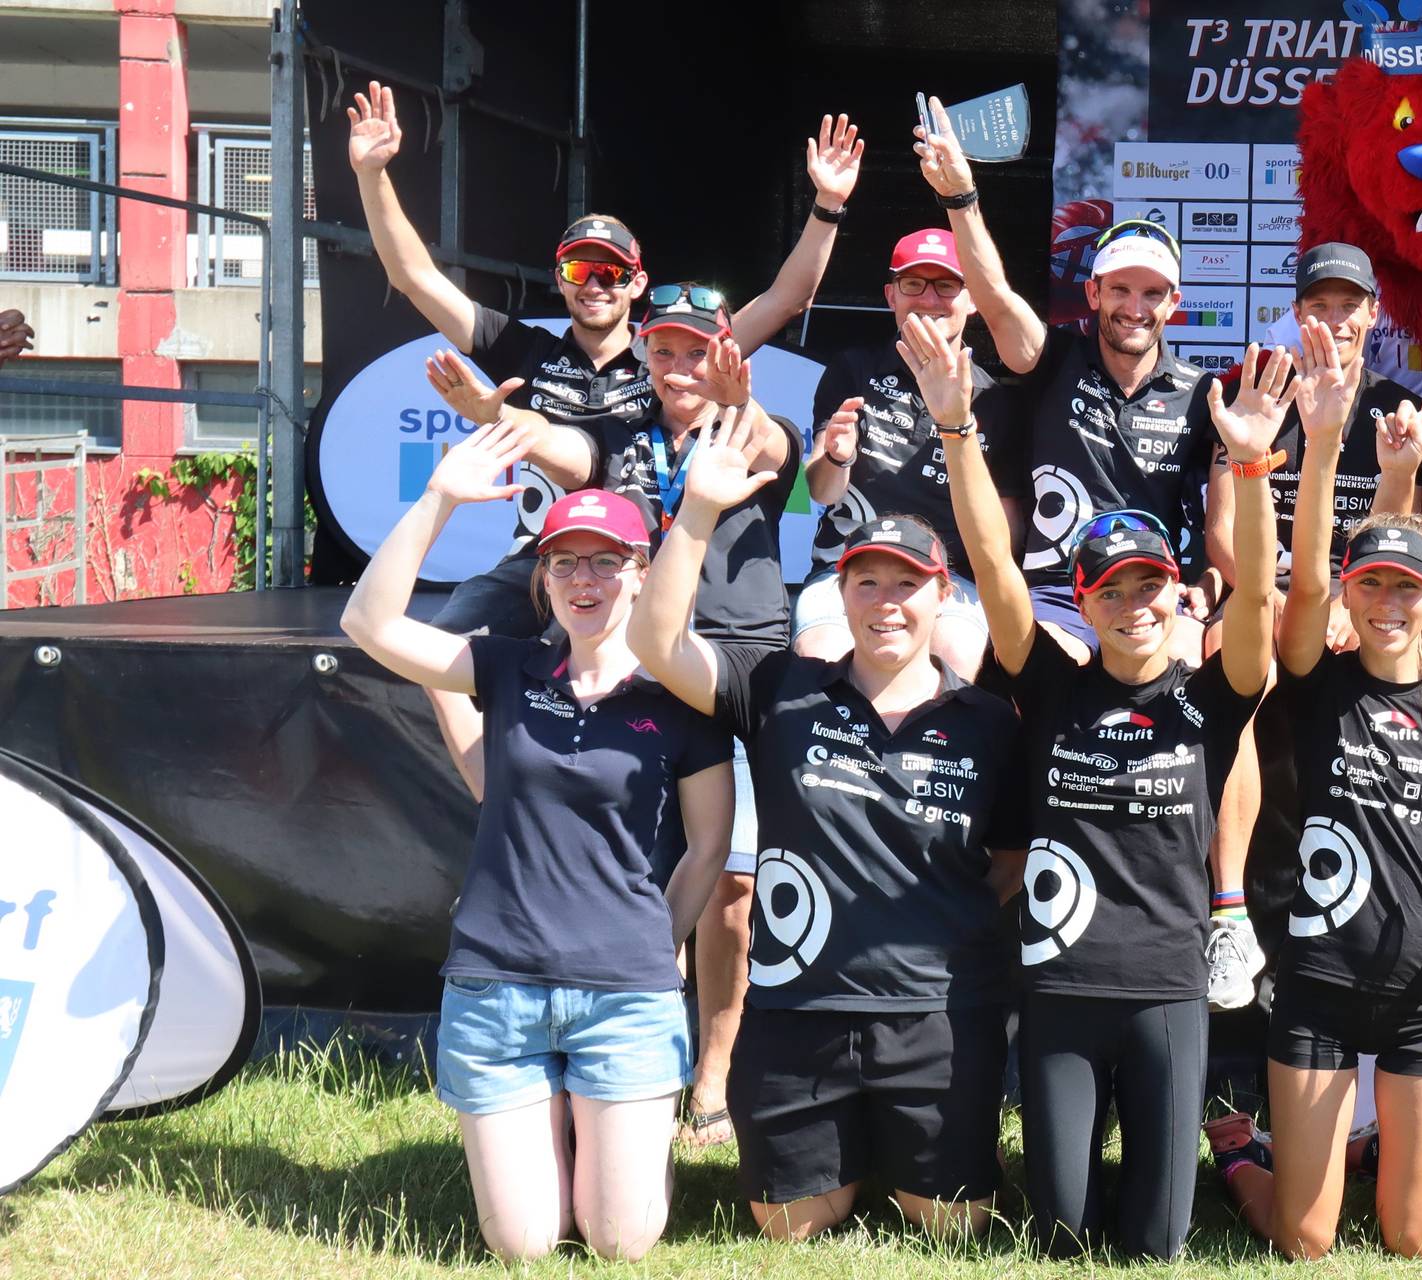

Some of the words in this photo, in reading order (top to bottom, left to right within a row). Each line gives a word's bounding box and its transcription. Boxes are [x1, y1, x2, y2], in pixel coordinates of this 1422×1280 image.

[1135, 161, 1190, 181] Bitburger
[1257, 223, 1291, 231] SPORTS
[1270, 215, 1293, 224] ultra
[1201, 255, 1225, 264] PASS
[1316, 259, 1361, 272] SENNHEISER
[1180, 300, 1234, 309] düsseldorf
[1152, 440, 1179, 455] SIV
[1147, 461, 1181, 473] gicom
[1348, 496, 1373, 510] SIV
[1182, 702, 1205, 724] TEAM
[811, 721, 864, 747] Krombacher
[921, 736, 948, 746] skinfit
[1098, 728, 1154, 741] skinfit
[1052, 743, 1096, 765] Krombacher
[832, 752, 887, 775] schmelzer
[1127, 754, 1196, 774] LINDENSCHMIDT
[1062, 772, 1116, 787] schmelzer
[1154, 777, 1185, 796] SIV
[933, 782, 965, 800] SIV
[1061, 782, 1098, 793] medien
[924, 806, 972, 828] gicom
[1147, 803, 1193, 818] gicom
